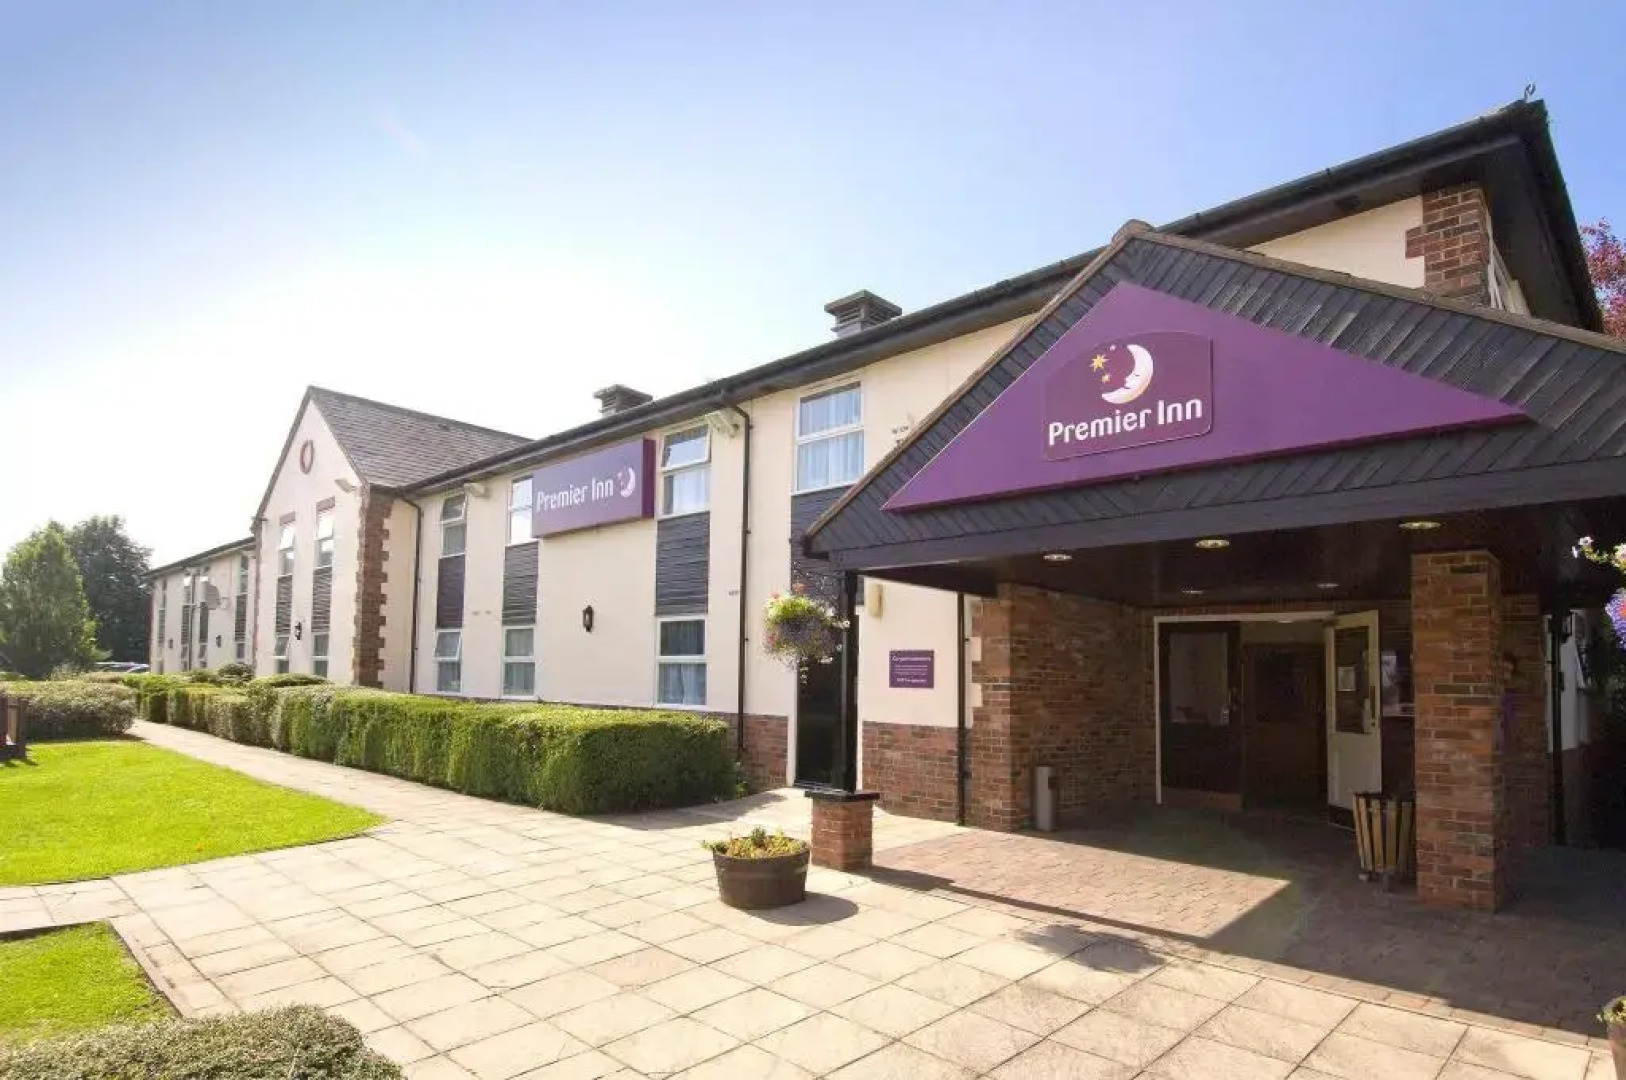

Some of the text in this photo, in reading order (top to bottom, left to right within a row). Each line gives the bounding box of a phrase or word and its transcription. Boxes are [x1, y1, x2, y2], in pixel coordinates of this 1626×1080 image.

[1049, 398, 1203, 446] Premier Inn
[536, 477, 614, 513] Premier Inn
